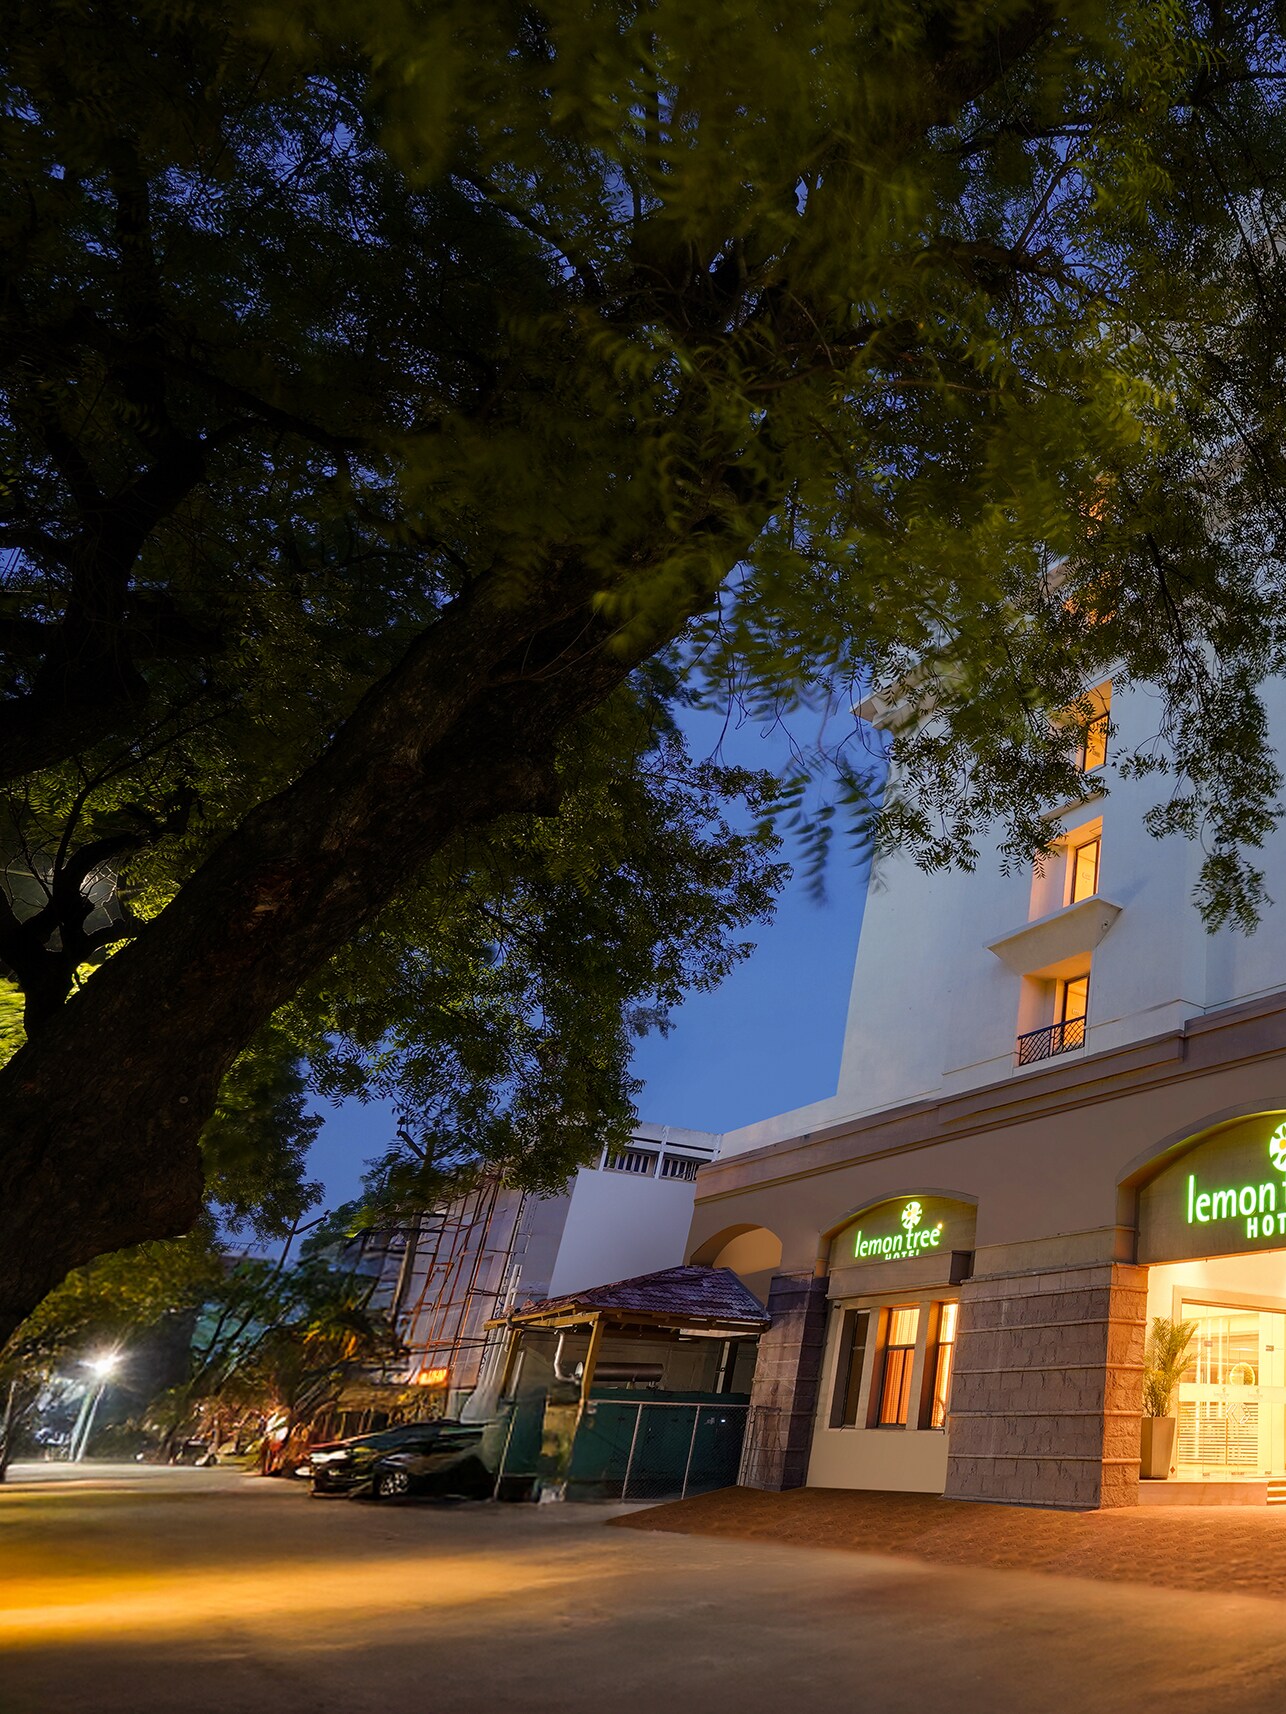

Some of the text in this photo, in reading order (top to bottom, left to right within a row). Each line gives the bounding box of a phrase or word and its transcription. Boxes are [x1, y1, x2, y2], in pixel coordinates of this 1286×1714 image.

[1187, 1174, 1275, 1224] lemon
[854, 1228, 941, 1258] lemon tree
